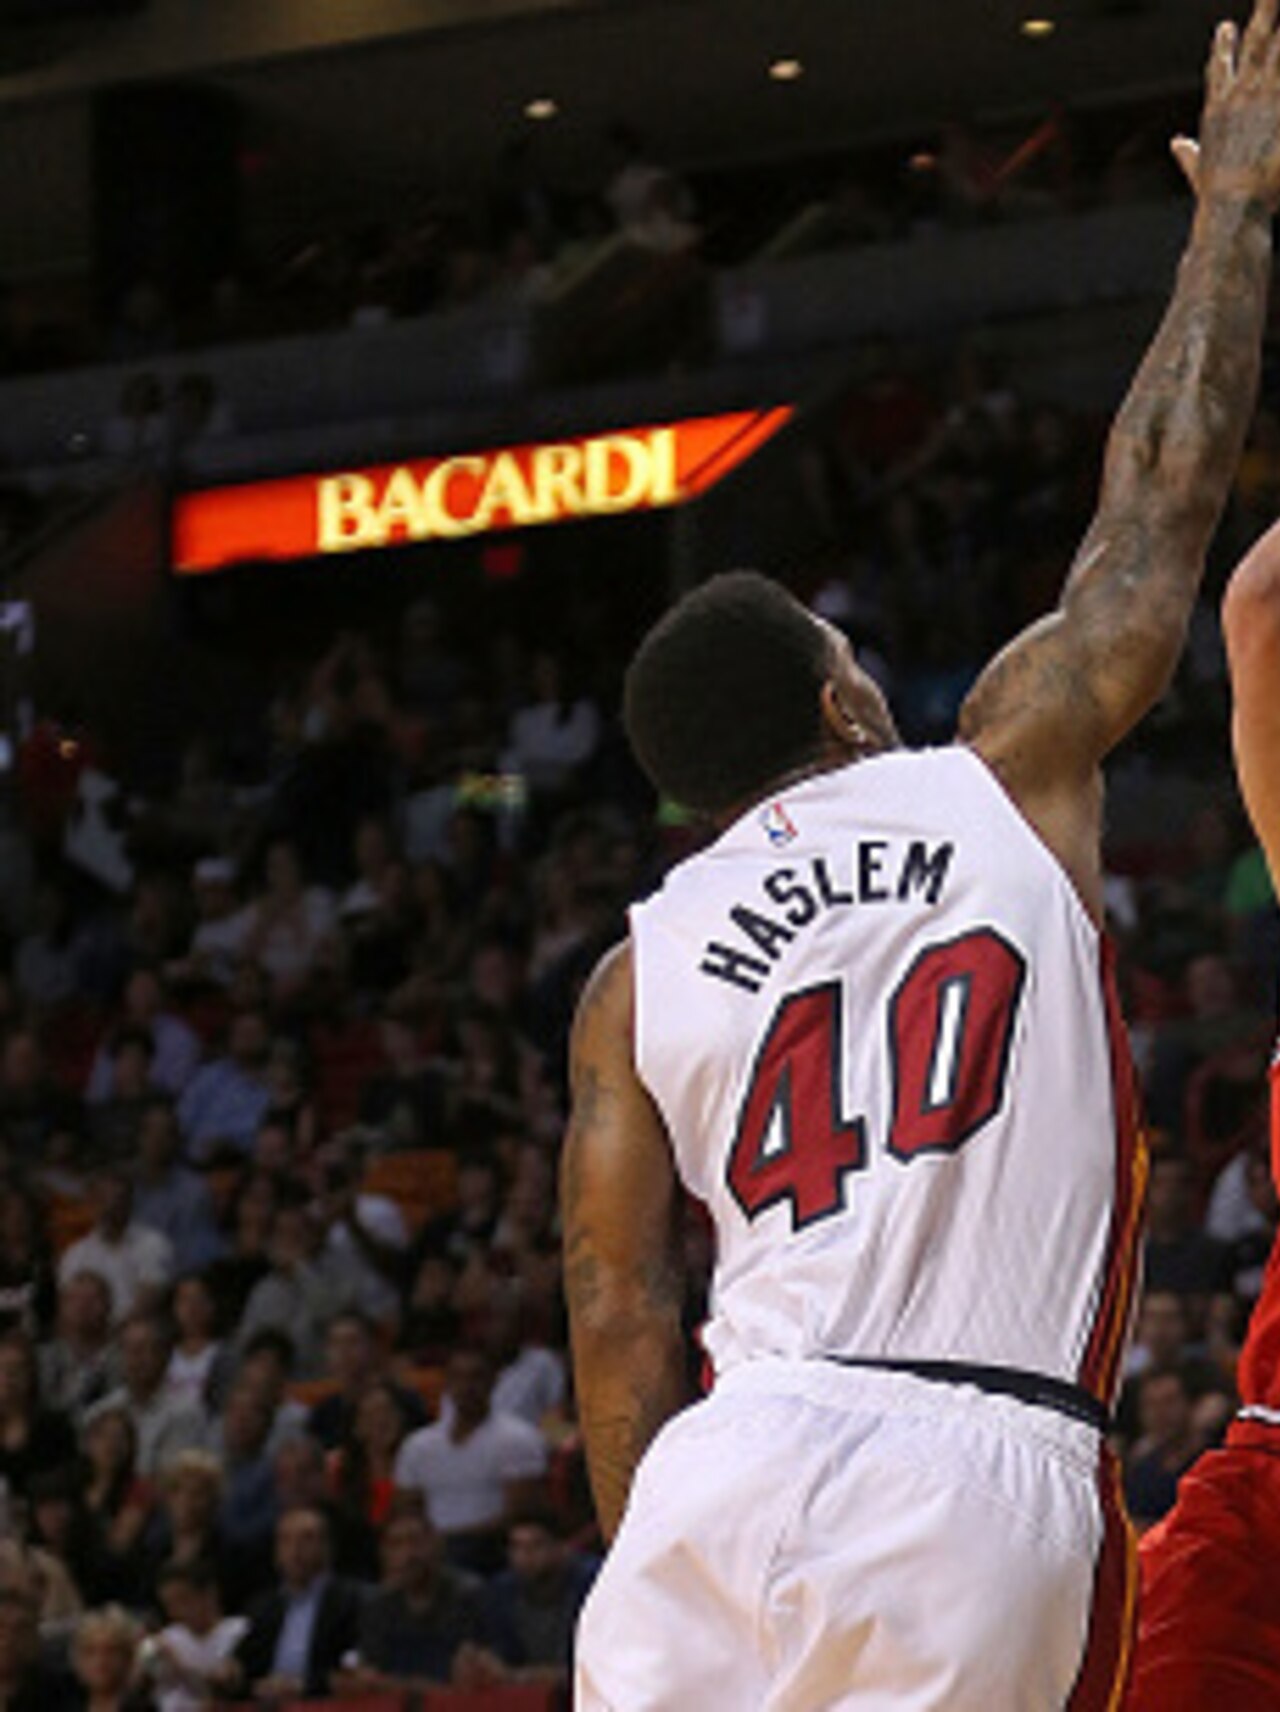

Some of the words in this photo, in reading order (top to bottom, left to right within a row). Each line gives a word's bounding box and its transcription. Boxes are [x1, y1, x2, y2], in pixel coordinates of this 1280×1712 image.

[316, 428, 676, 552] BACARDI
[700, 841, 954, 993] HASLEM
[725, 926, 1027, 1232] 40
